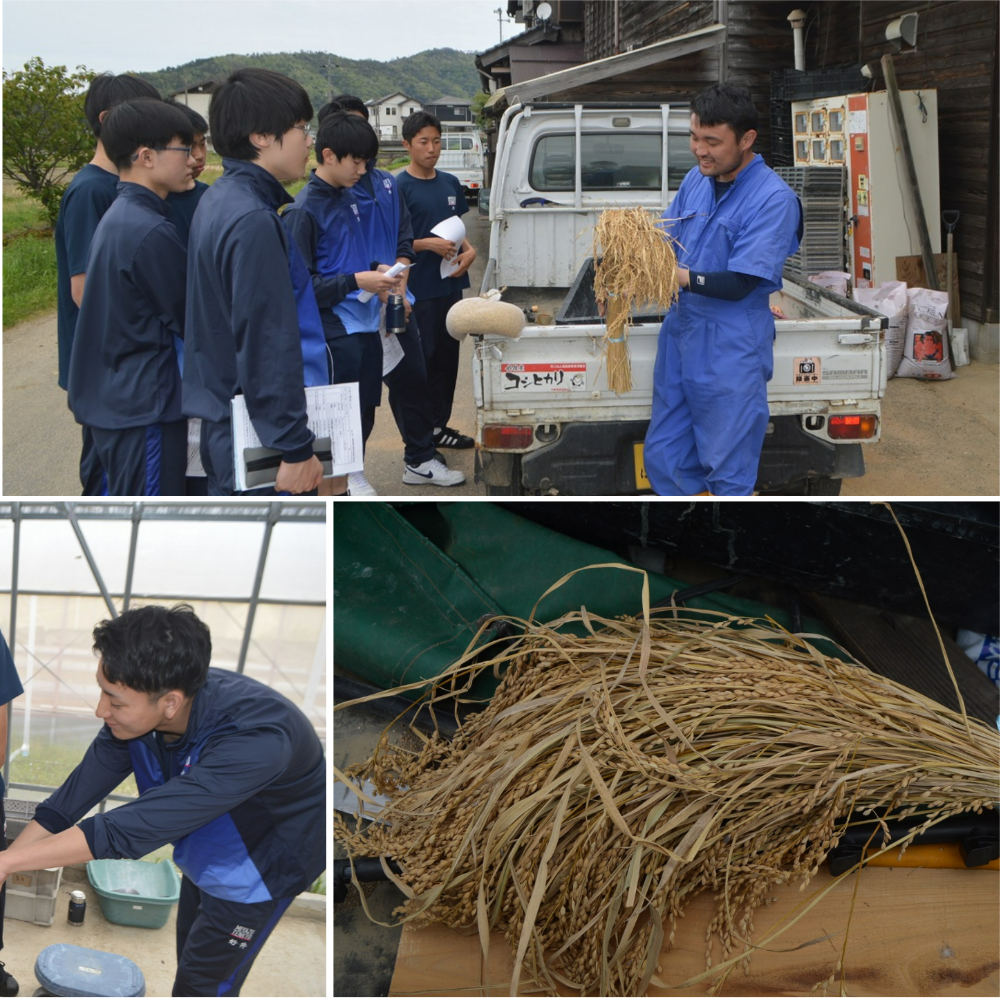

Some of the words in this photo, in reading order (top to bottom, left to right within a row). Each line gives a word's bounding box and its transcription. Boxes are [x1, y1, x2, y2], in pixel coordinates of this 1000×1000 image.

[504, 369, 564, 390] コシヒカリ
